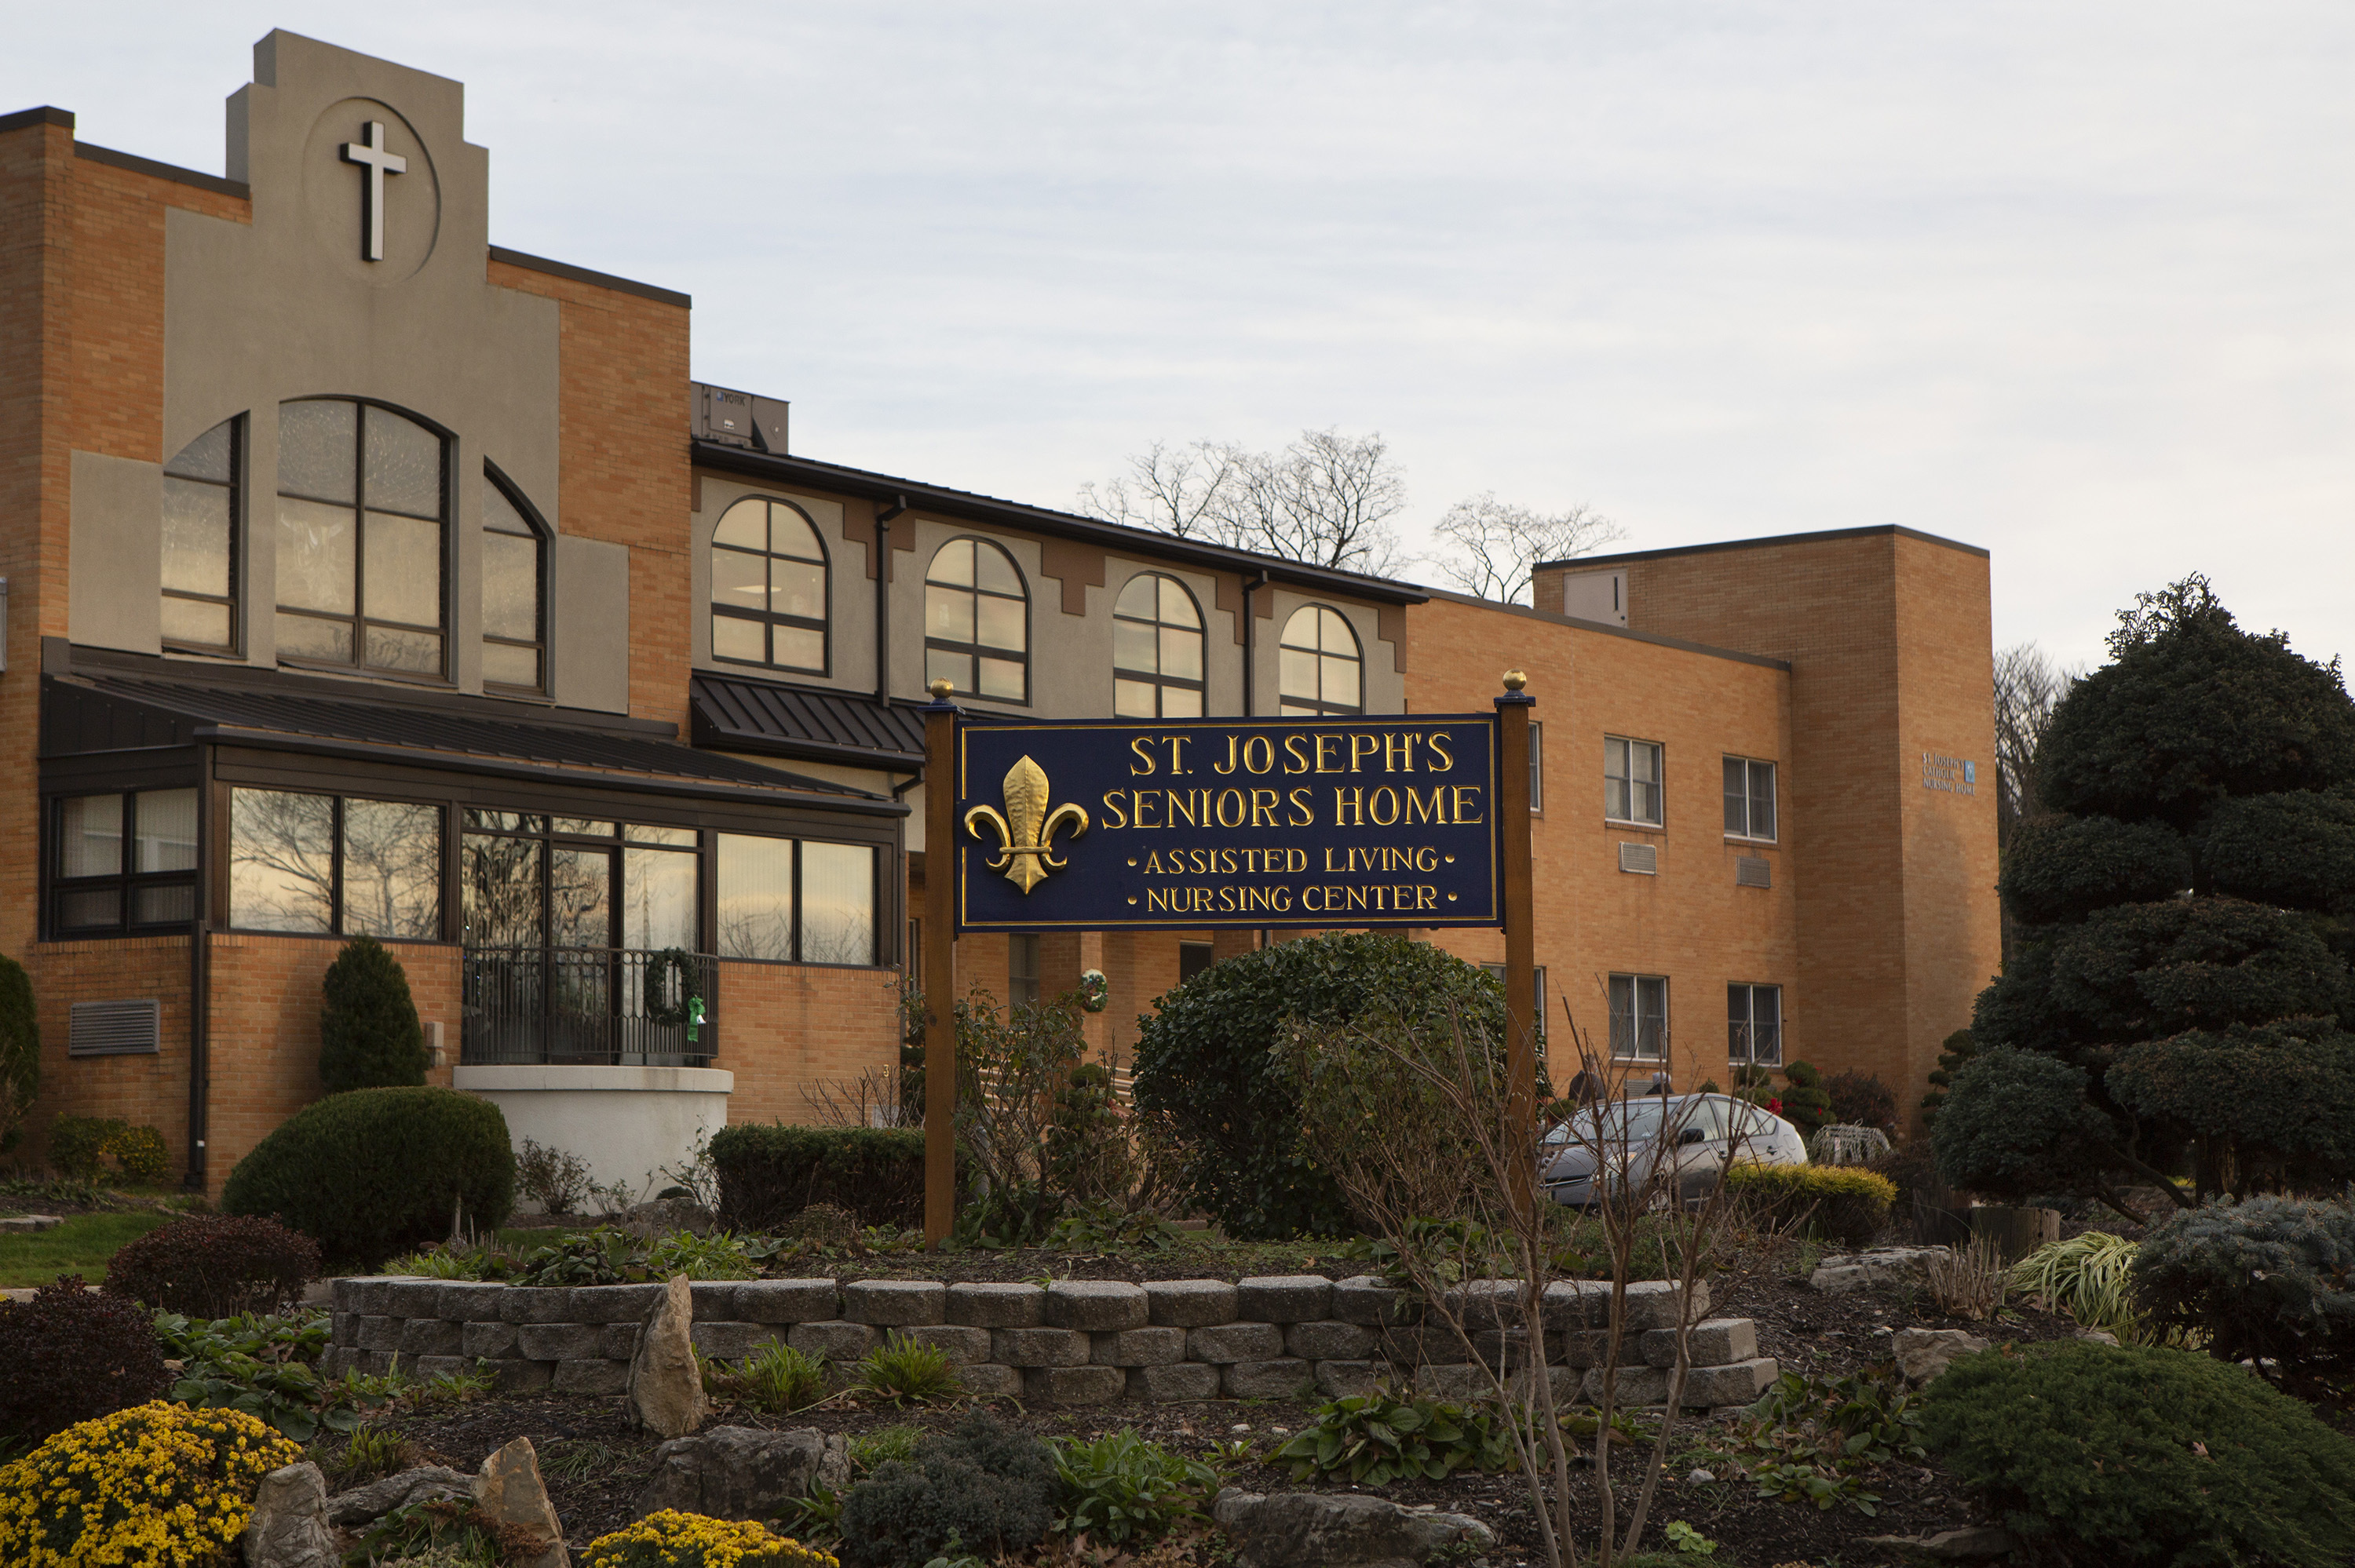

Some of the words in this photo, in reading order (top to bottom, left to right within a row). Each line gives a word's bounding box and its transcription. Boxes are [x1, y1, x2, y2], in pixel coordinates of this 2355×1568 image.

[724, 392, 745, 407] YORK
[1130, 736, 1193, 775] ST.
[1214, 732, 1453, 774] JOSEPH'S
[1922, 764, 1956, 782] CATHOLIC
[1922, 777, 1953, 793] NURSING
[1102, 786, 1314, 829] SENIORS
[1334, 785, 1483, 826] HOME
[1143, 848, 1308, 873] ASSISTED
[1325, 847, 1438, 871] LIVING
[1147, 885, 1292, 912] NURSING
[1302, 885, 1437, 910] CENTER
